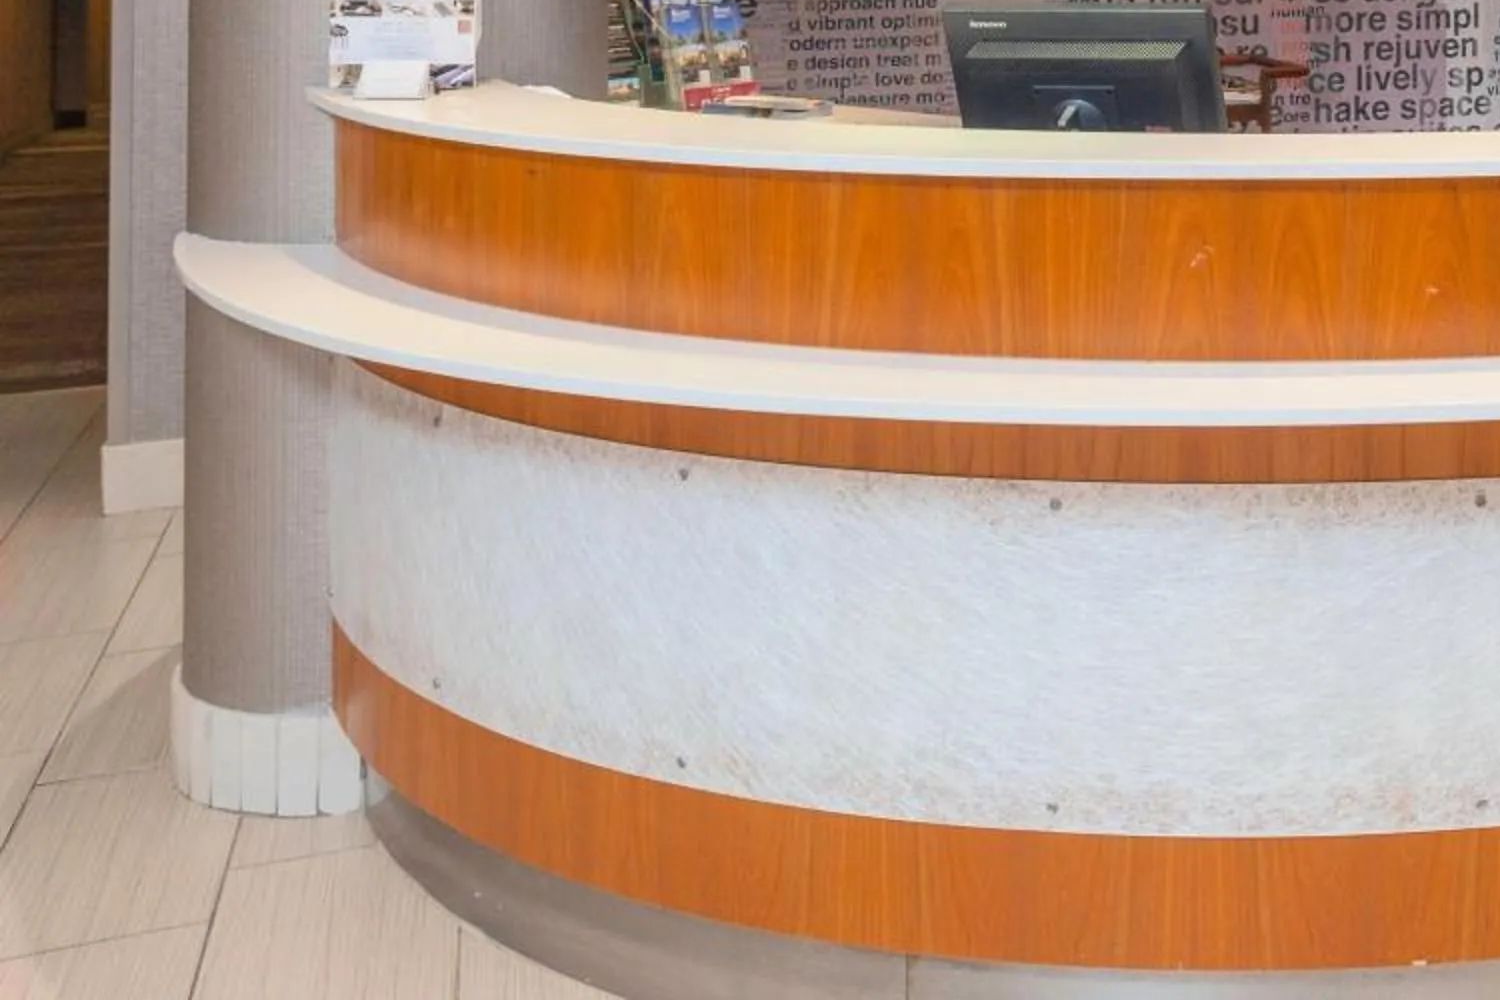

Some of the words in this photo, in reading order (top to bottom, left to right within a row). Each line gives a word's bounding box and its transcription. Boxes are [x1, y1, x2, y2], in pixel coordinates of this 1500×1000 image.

[807, 13, 875, 31] vibrant
[1304, 10, 1386, 34] more
[1396, 2, 1479, 35] simpl
[1363, 34, 1478, 67] rejuven
[876, 71, 916, 87] love
[1308, 70, 1345, 93] ce
[1356, 63, 1437, 95] lively
[1313, 95, 1390, 124] hake
[1400, 94, 1492, 124] space
